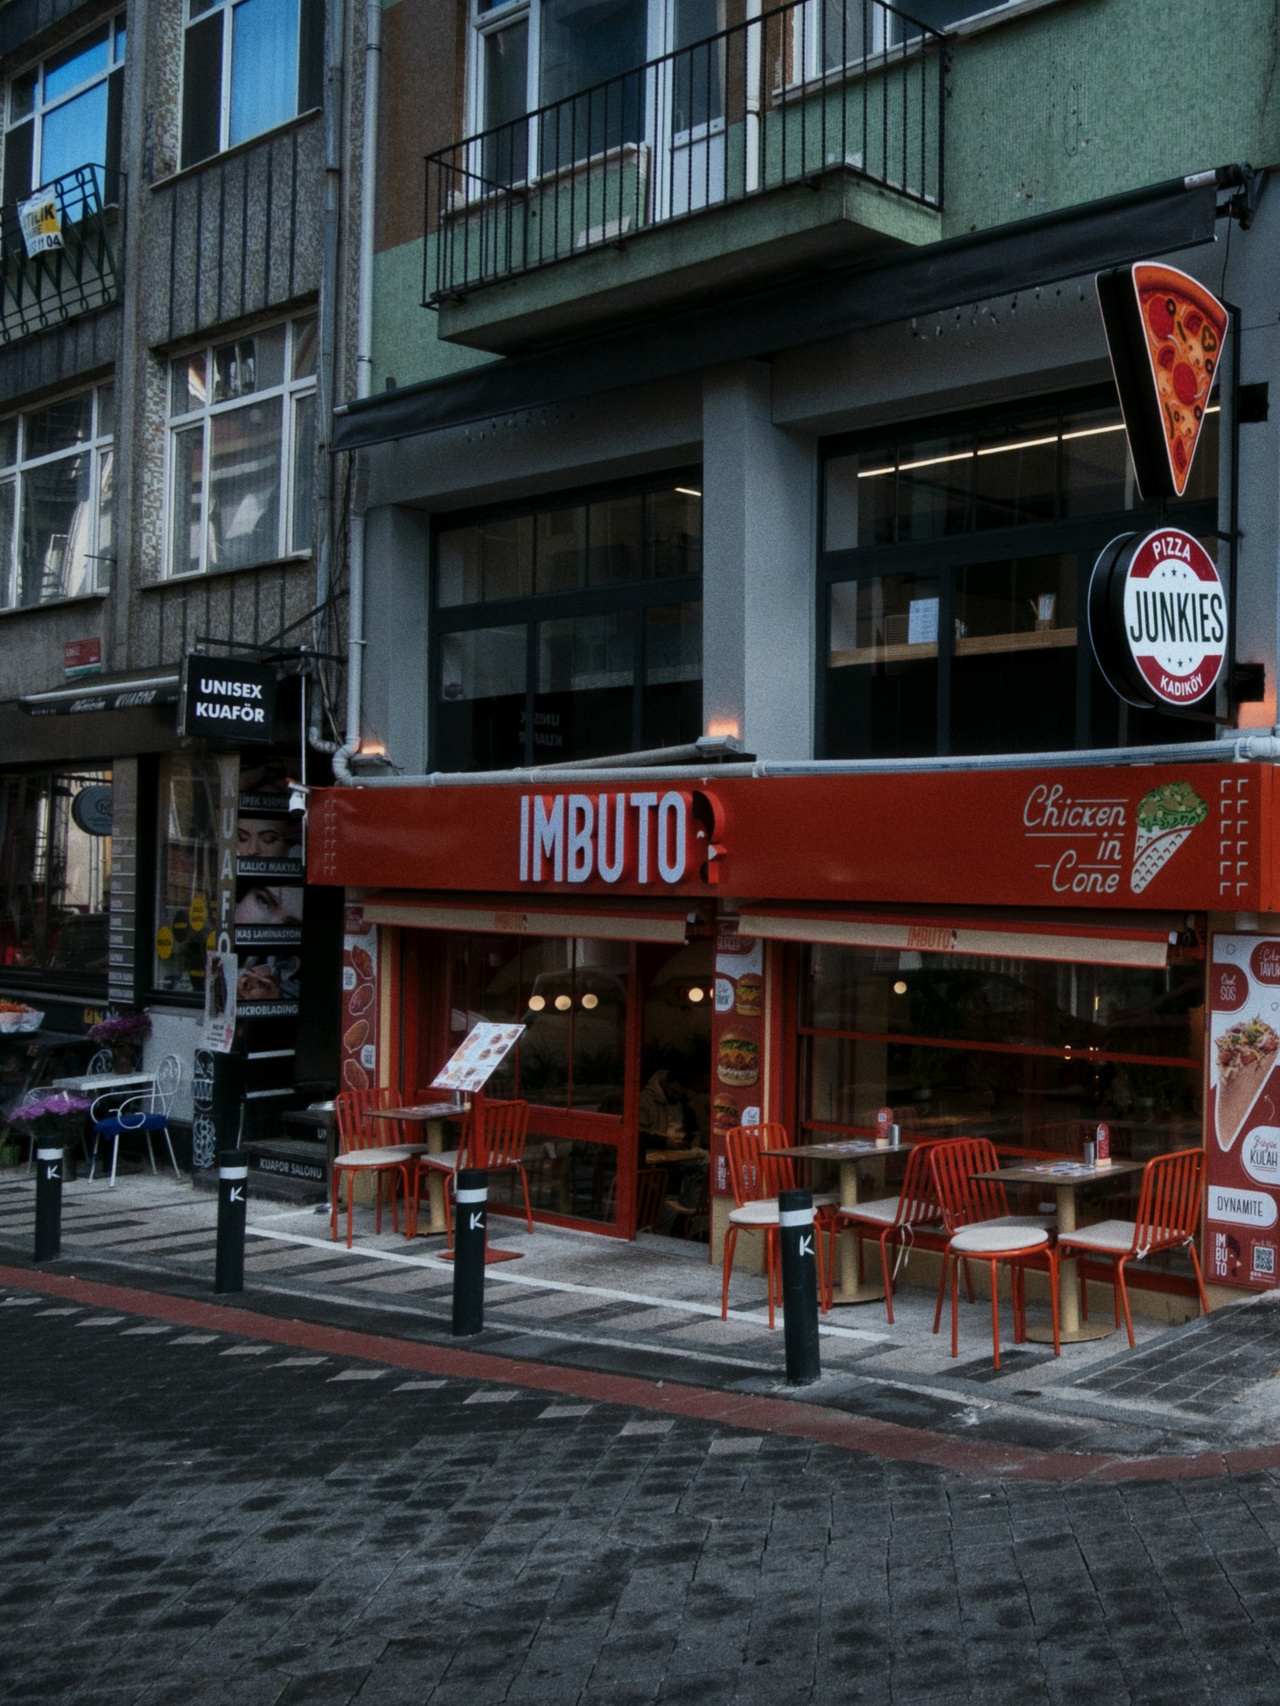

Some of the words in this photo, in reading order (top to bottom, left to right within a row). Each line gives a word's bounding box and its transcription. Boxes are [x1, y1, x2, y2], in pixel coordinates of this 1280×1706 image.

[46, 234, 62, 247] 04
[1152, 537, 1192, 562] PIZZA
[1130, 591, 1225, 643] JUNKIES
[200, 679, 263, 699] UNISEX
[1160, 673, 1204, 697] KADIKÖY
[195, 703, 266, 724] KUAFÖR
[1023, 784, 1126, 829] Chicken
[519, 791, 687, 884] IMBUTO
[1097, 831, 1122, 862] in
[240, 860, 267, 872] KALICI
[268, 861, 301, 873] MAKYAJ
[1052, 849, 1120, 894] Cone
[907, 926, 951, 950] IMBUTO
[1220, 985, 1237, 1001] SOS
[236, 1003, 300, 1017] MICROBLADING
[291, 1163, 323, 1179] SALONU
[1217, 1195, 1264, 1217] DYNAMITE
[1215, 1232, 1226, 1248] IM
[1215, 1246, 1228, 1262] BU
[1215, 1260, 1228, 1276] TO
